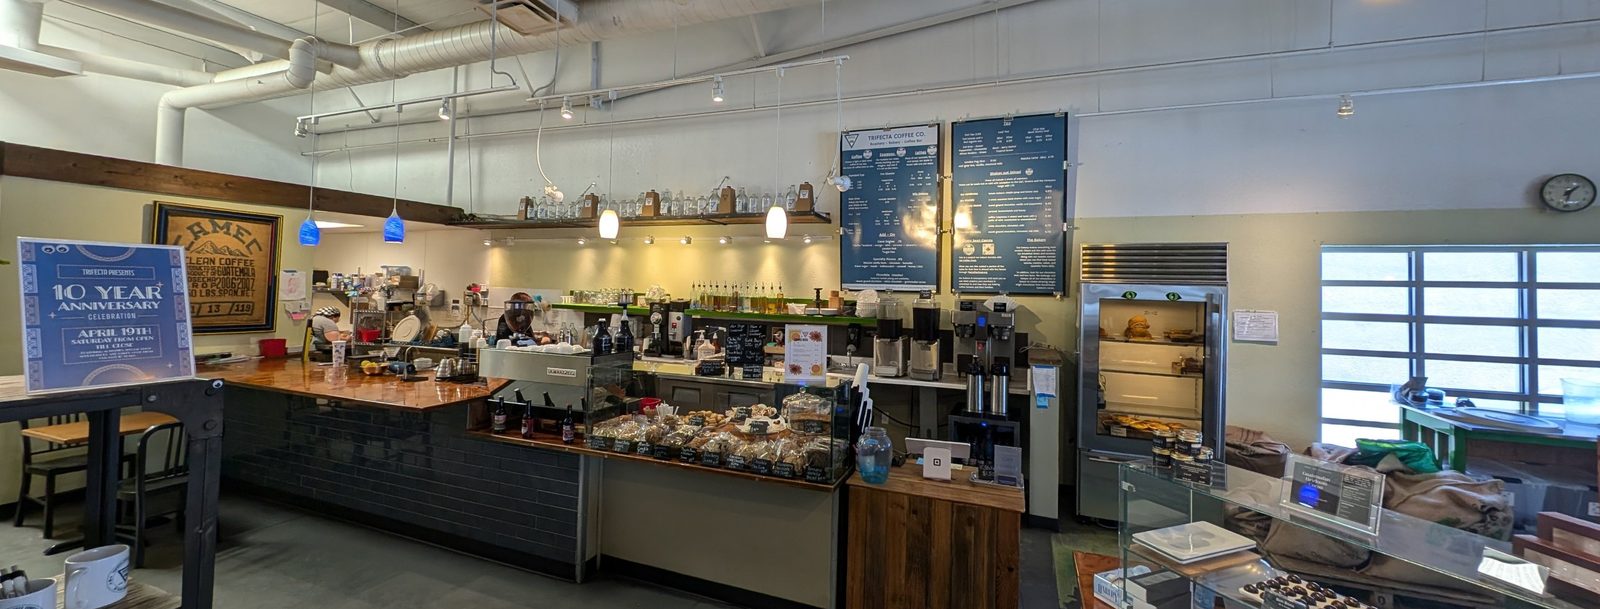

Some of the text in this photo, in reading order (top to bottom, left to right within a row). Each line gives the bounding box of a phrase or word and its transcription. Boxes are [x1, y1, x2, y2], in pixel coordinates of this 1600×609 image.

[219, 257, 255, 267] COFFEE
[217, 266, 256, 277] GUATEMALA
[52, 284, 163, 300] 10 YEAR
[58, 301, 160, 311] ANNIVERSARY
[208, 304, 220, 313] 13
[78, 327, 152, 338] APRIL 19TH
